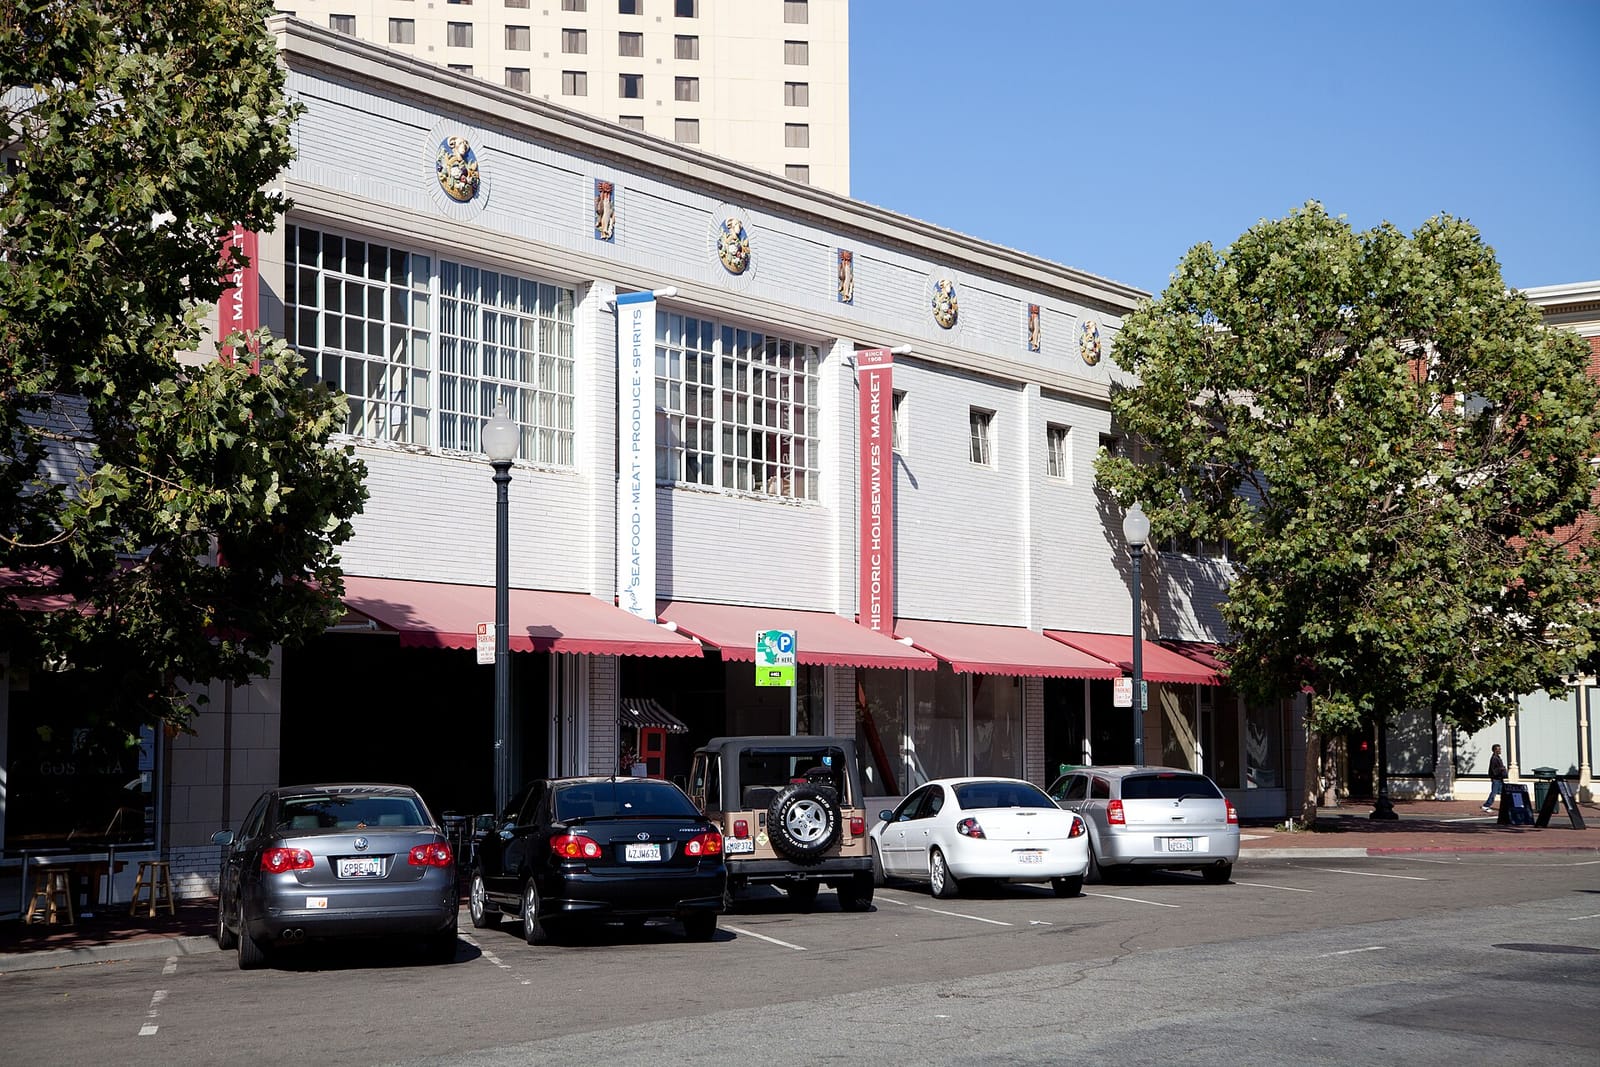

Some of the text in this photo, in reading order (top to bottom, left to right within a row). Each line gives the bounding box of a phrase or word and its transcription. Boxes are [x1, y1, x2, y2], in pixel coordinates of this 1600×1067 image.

[233, 231, 243, 320] MART
[633, 309, 641, 367] SPIRITS
[632, 377, 640, 452] PRODUCE
[632, 463, 640, 503] MEAT
[870, 372, 880, 630] HISTORIC HOUSEWIVES' MARKET
[631, 513, 641, 586] SEAFOOD
